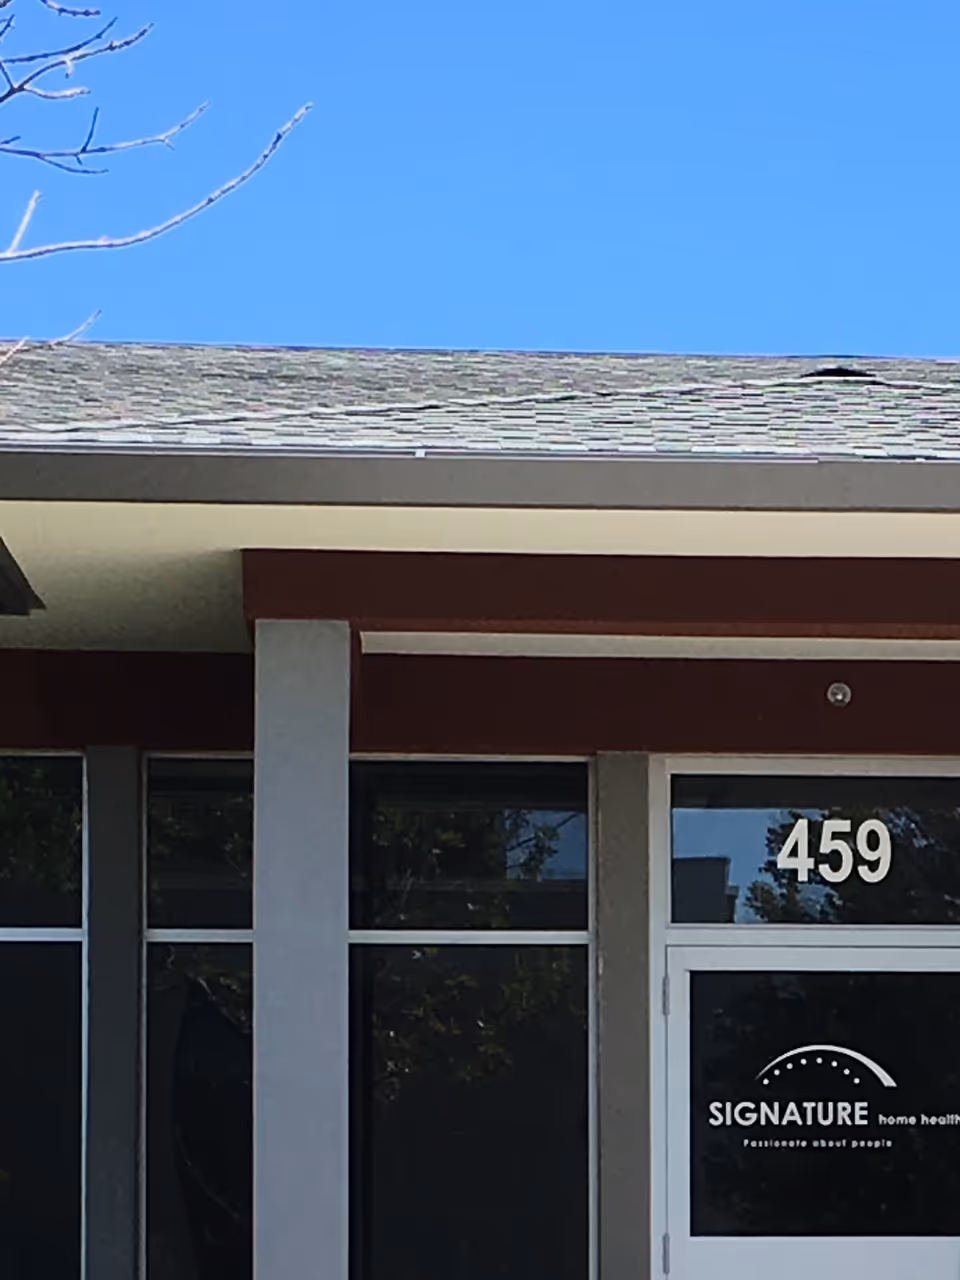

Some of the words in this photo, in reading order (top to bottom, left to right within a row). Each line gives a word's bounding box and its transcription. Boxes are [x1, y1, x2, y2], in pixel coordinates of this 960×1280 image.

[776, 818, 892, 884] 459
[708, 1101, 869, 1127] SIGNATURE
[878, 1113, 917, 1126] home
[743, 1138, 808, 1149] Passionate
[812, 1138, 847, 1149] about
[851, 1138, 893, 1149] people
